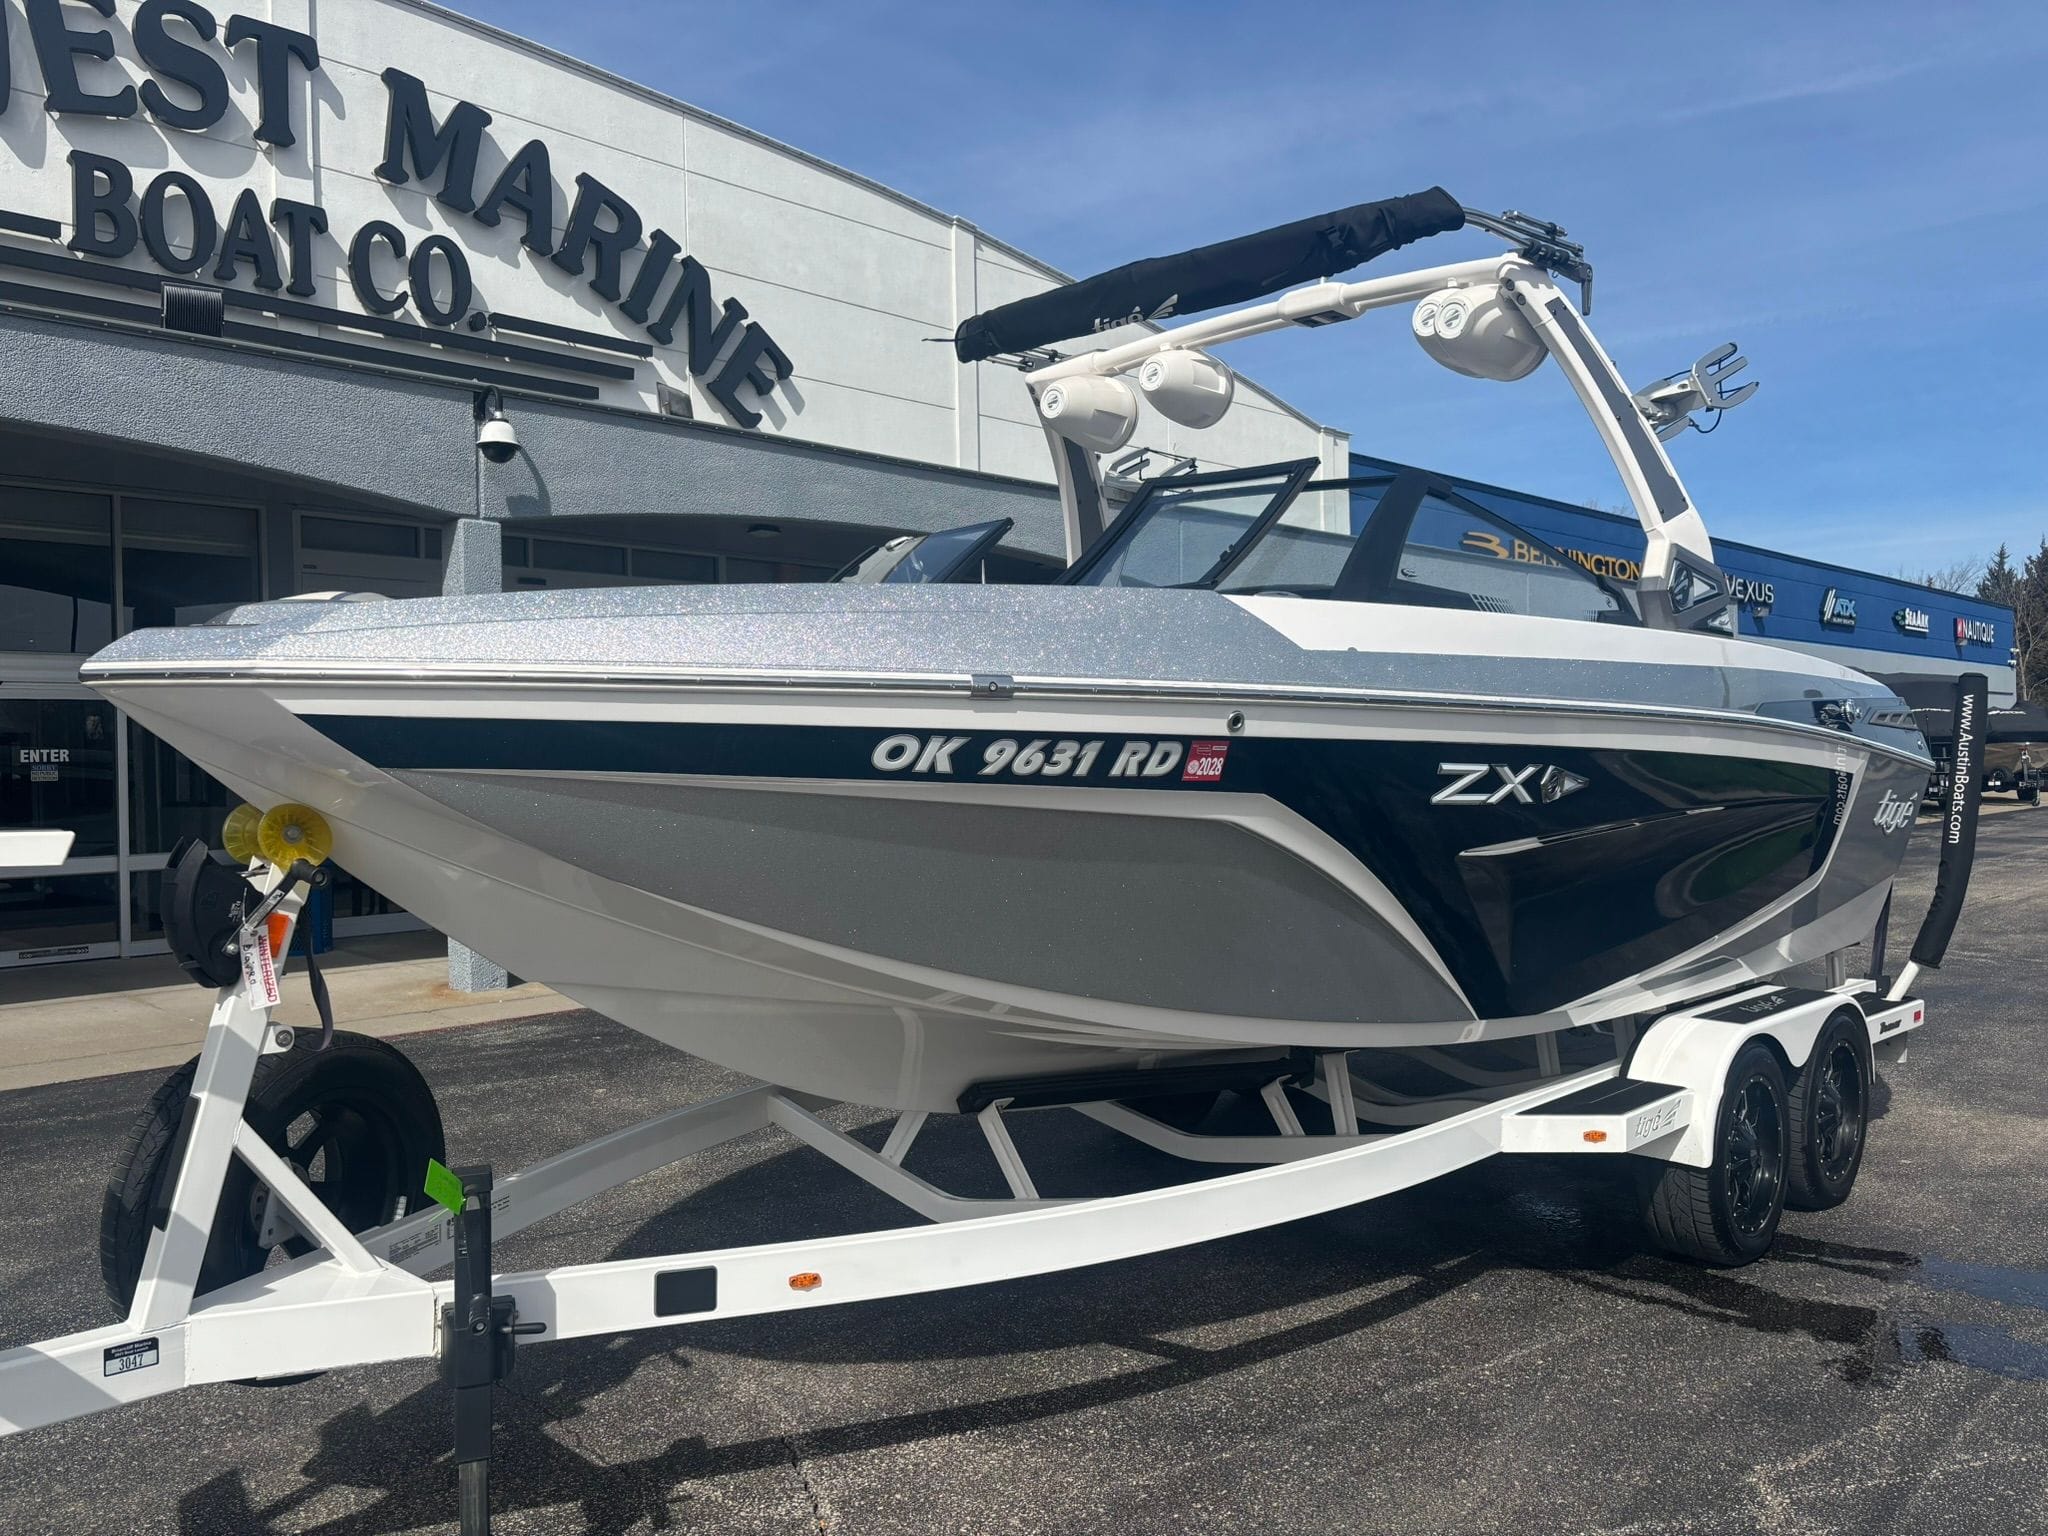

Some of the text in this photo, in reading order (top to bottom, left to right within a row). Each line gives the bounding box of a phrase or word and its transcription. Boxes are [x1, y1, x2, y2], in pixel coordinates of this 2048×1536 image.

[0, 0, 794, 430] EST MARINE
[67, 149, 486, 332] BOAT CO.
[1724, 573, 1774, 603] VEXUS
[1833, 599, 1857, 618] ATX
[1963, 623, 1995, 643] NAUTIQUE
[20, 749, 70, 763] ENTER
[871, 734, 1184, 777] OK 9631 RD
[1196, 757, 1224, 776] 2028
[1948, 694, 1975, 844] www.AustinBoats.com
[1873, 789, 1919, 833] tigé
[258, 934, 278, 1003] WINTERIZED
[1634, 1108, 1662, 1138] tigé
[119, 1354, 144, 1370] 3047
